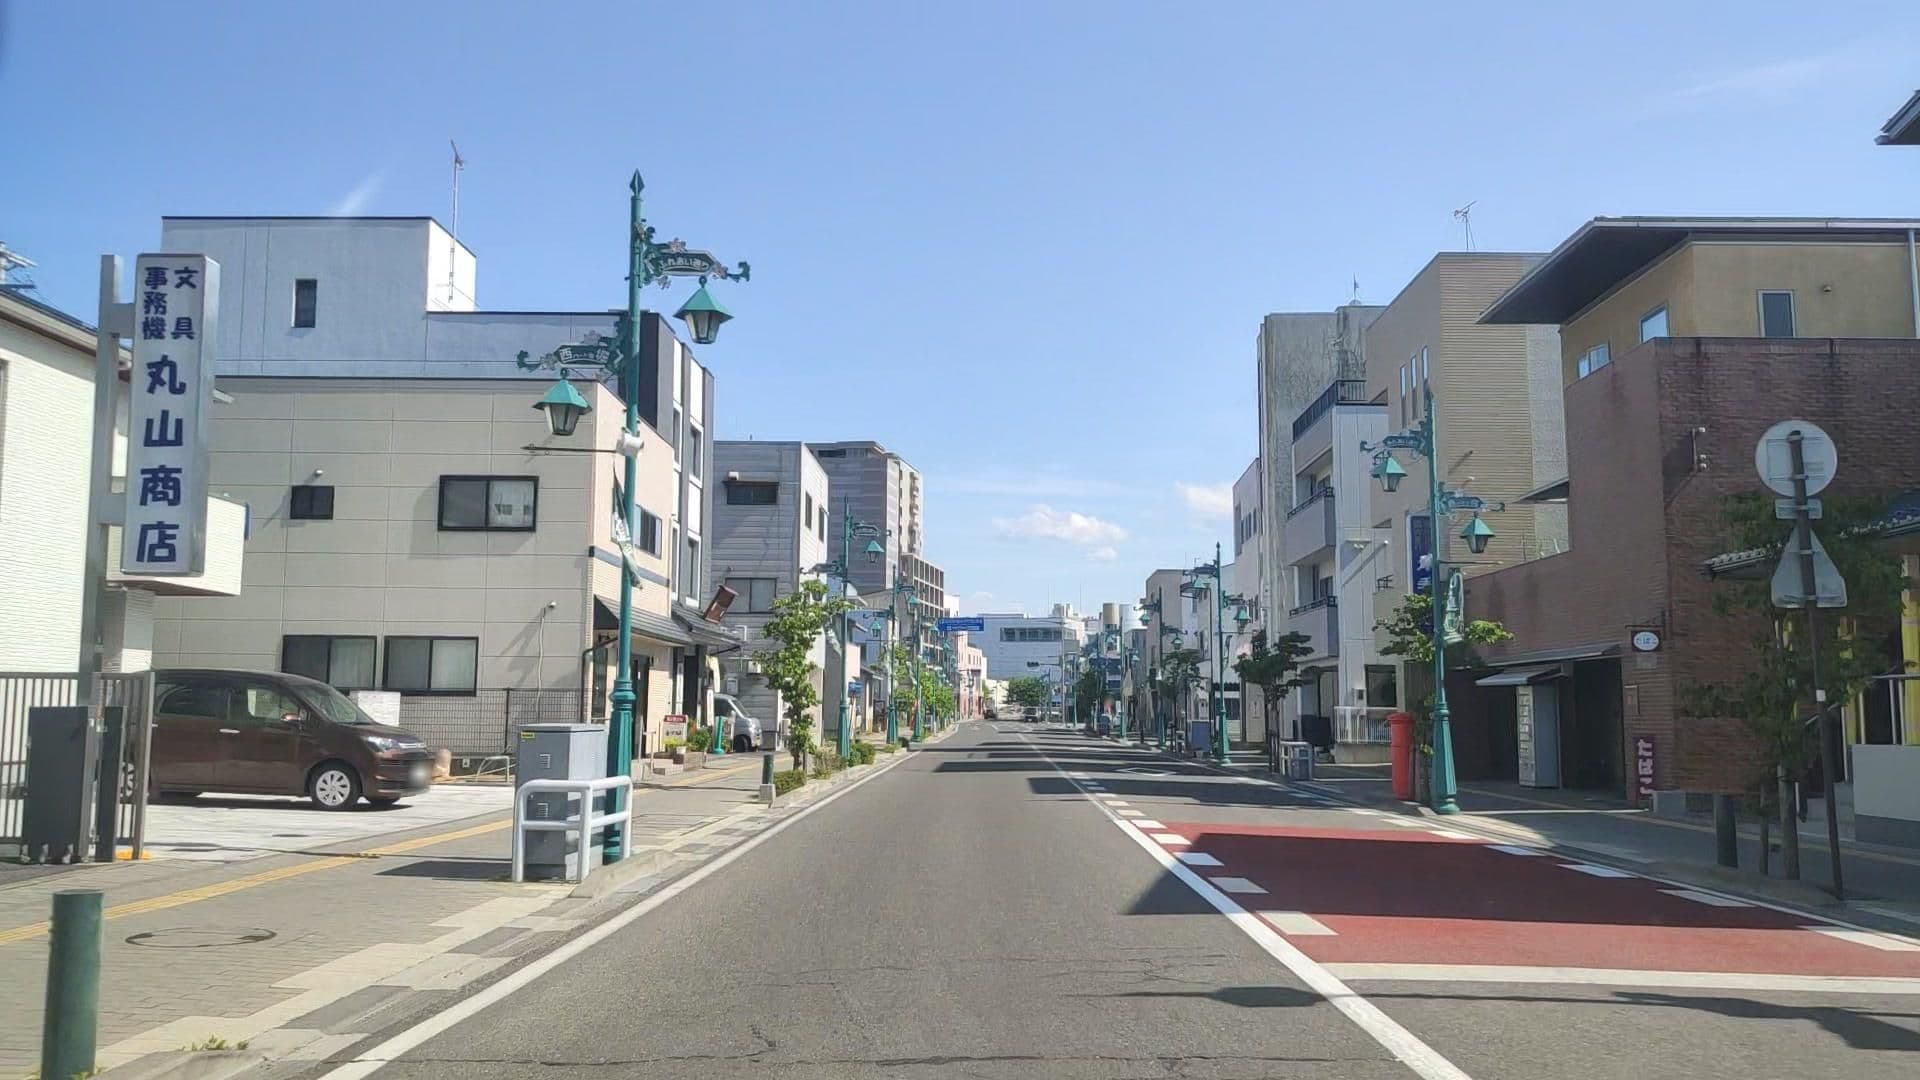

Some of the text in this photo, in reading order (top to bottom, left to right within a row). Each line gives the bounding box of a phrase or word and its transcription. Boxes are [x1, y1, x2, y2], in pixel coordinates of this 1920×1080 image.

[142, 266, 169, 340] 事務機
[170, 266, 199, 340] 文具
[135, 354, 187, 563] 丸山商店
